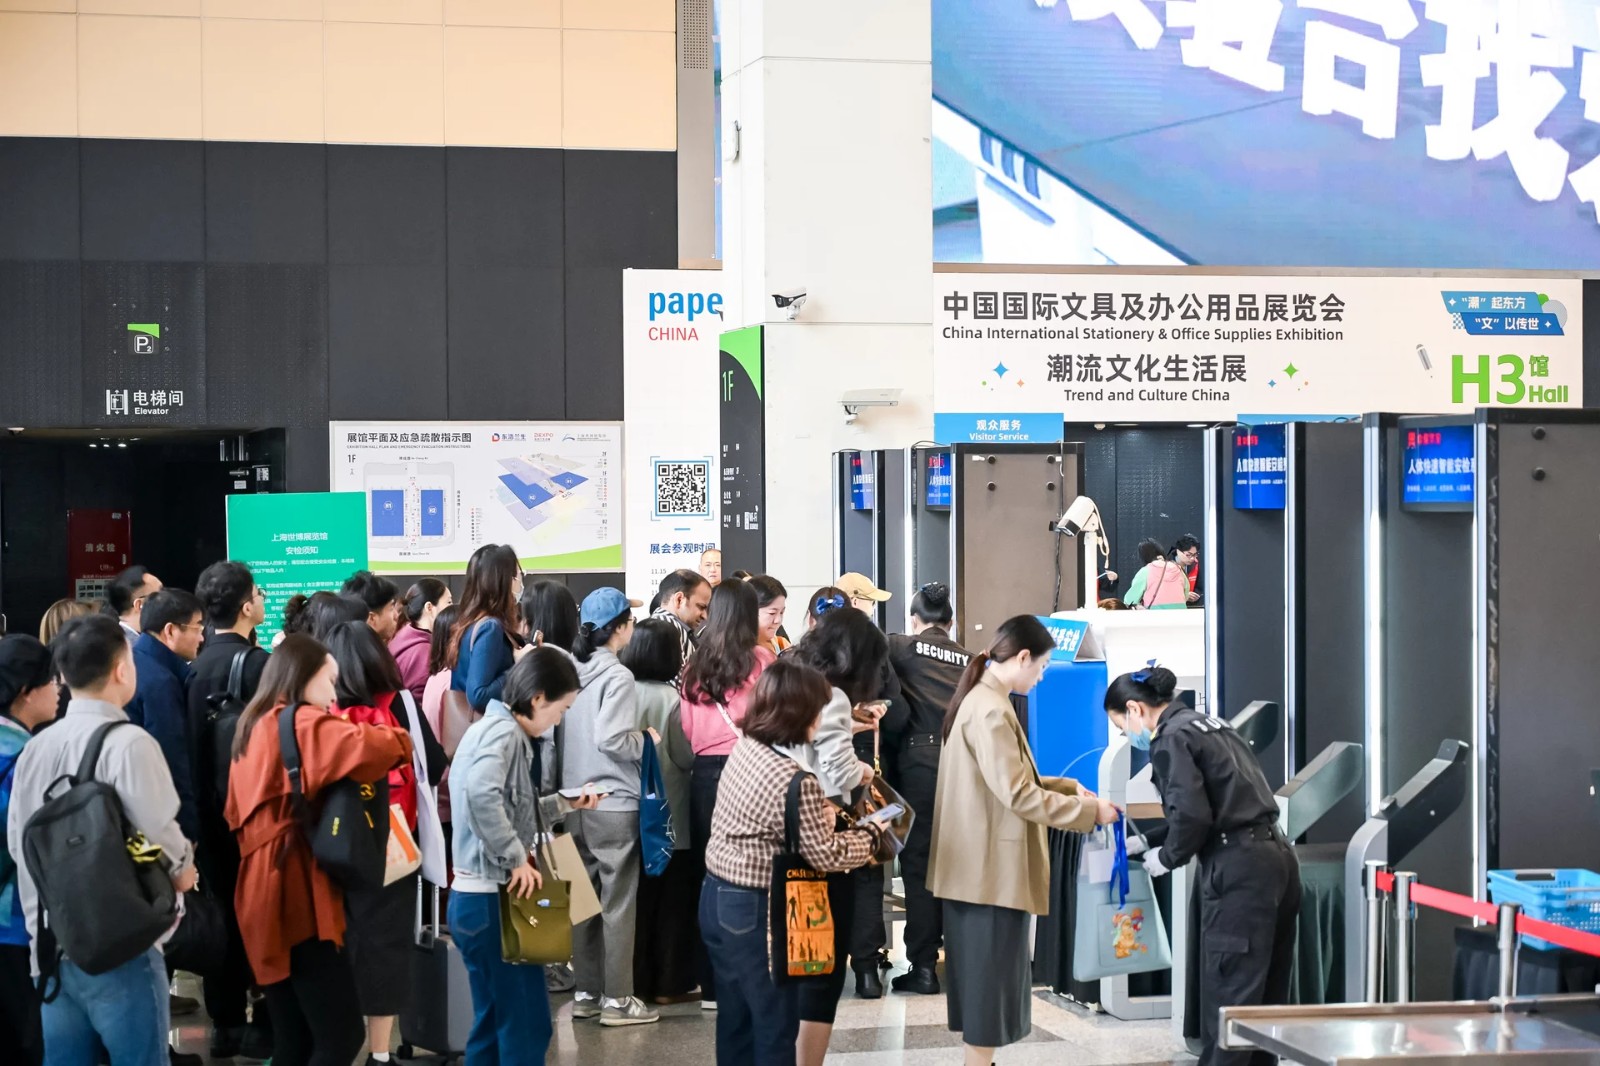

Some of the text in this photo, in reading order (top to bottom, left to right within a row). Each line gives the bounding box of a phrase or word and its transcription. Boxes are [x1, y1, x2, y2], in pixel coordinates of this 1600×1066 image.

[943, 291, 1346, 322] 中国国际文具及办公用品展览会
[648, 327, 699, 341] CHINA
[942, 326, 1344, 343] China International Stationery & Office Supplies Exhibition
[1047, 354, 1247, 383] 潮流文化生活展
[1529, 355, 1549, 378] 馆
[722, 370, 734, 402] 1F
[1452, 354, 1526, 405] H3
[133, 390, 183, 406] 电梯间
[1064, 389, 1230, 401] Trend and Culture China
[1529, 385, 1568, 403] Hall
[134, 407, 169, 415] Elevator
[976, 419, 1022, 431] 观众服务
[347, 433, 472, 443] 展馆平面及应急疏散指示图
[969, 432, 1029, 441] Visitor Service
[272, 532, 328, 542] 上海世博展览馆
[286, 546, 318, 555] 安检须知
[650, 543, 716, 554] 展会参观时间
[916, 642, 969, 667] SECURITY
